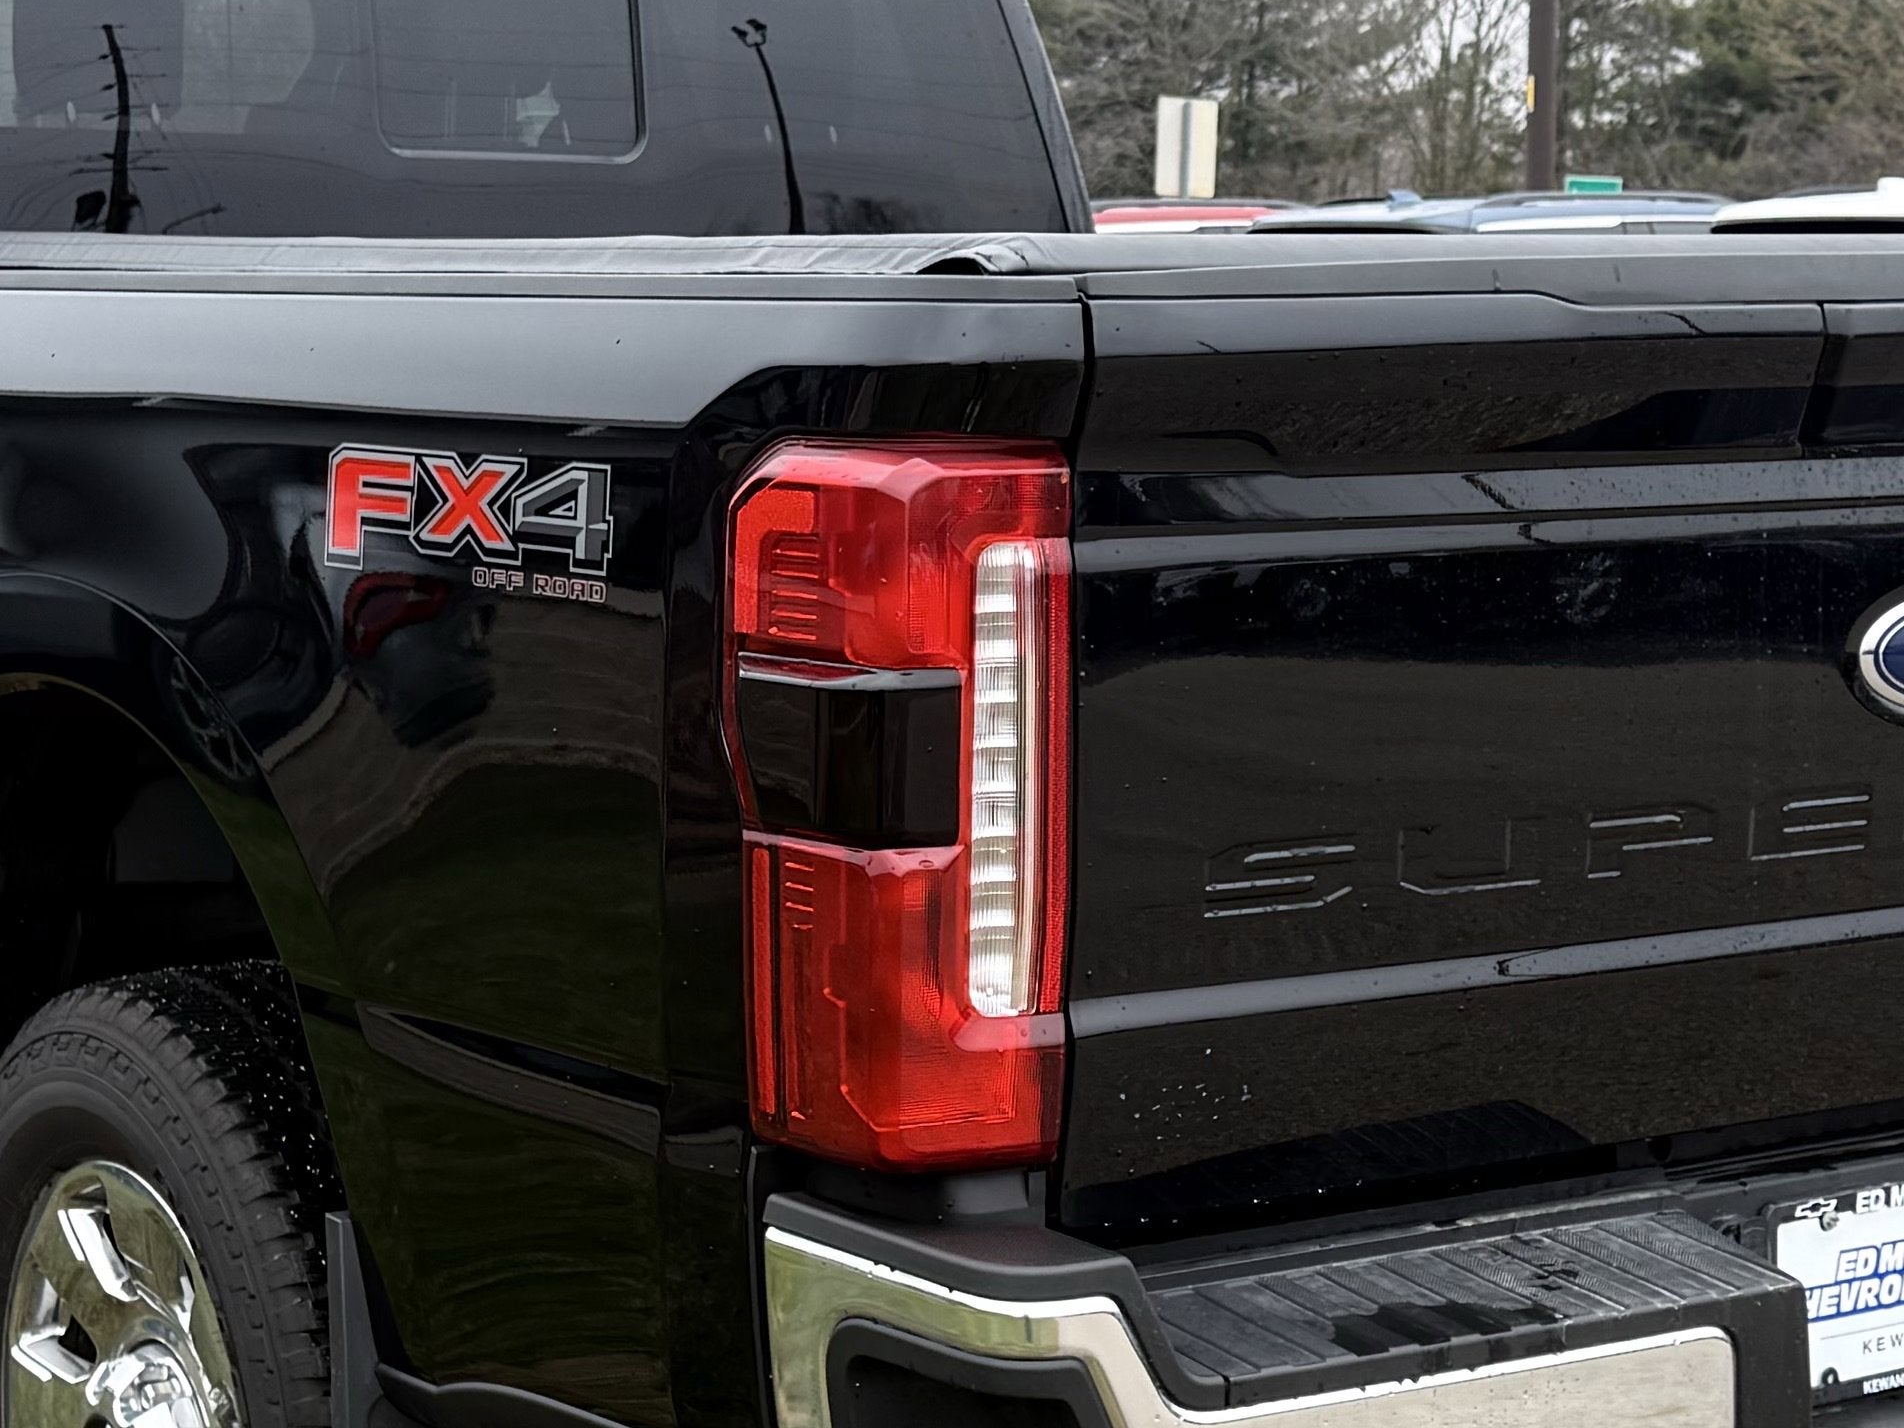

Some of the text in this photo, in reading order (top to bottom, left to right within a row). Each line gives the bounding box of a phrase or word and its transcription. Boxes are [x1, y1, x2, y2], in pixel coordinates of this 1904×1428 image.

[325, 442, 613, 576] FX4
[472, 566, 607, 603] OFF ROAD
[1855, 1189, 1885, 1213] ED
[1835, 1245, 1880, 1282] ED
